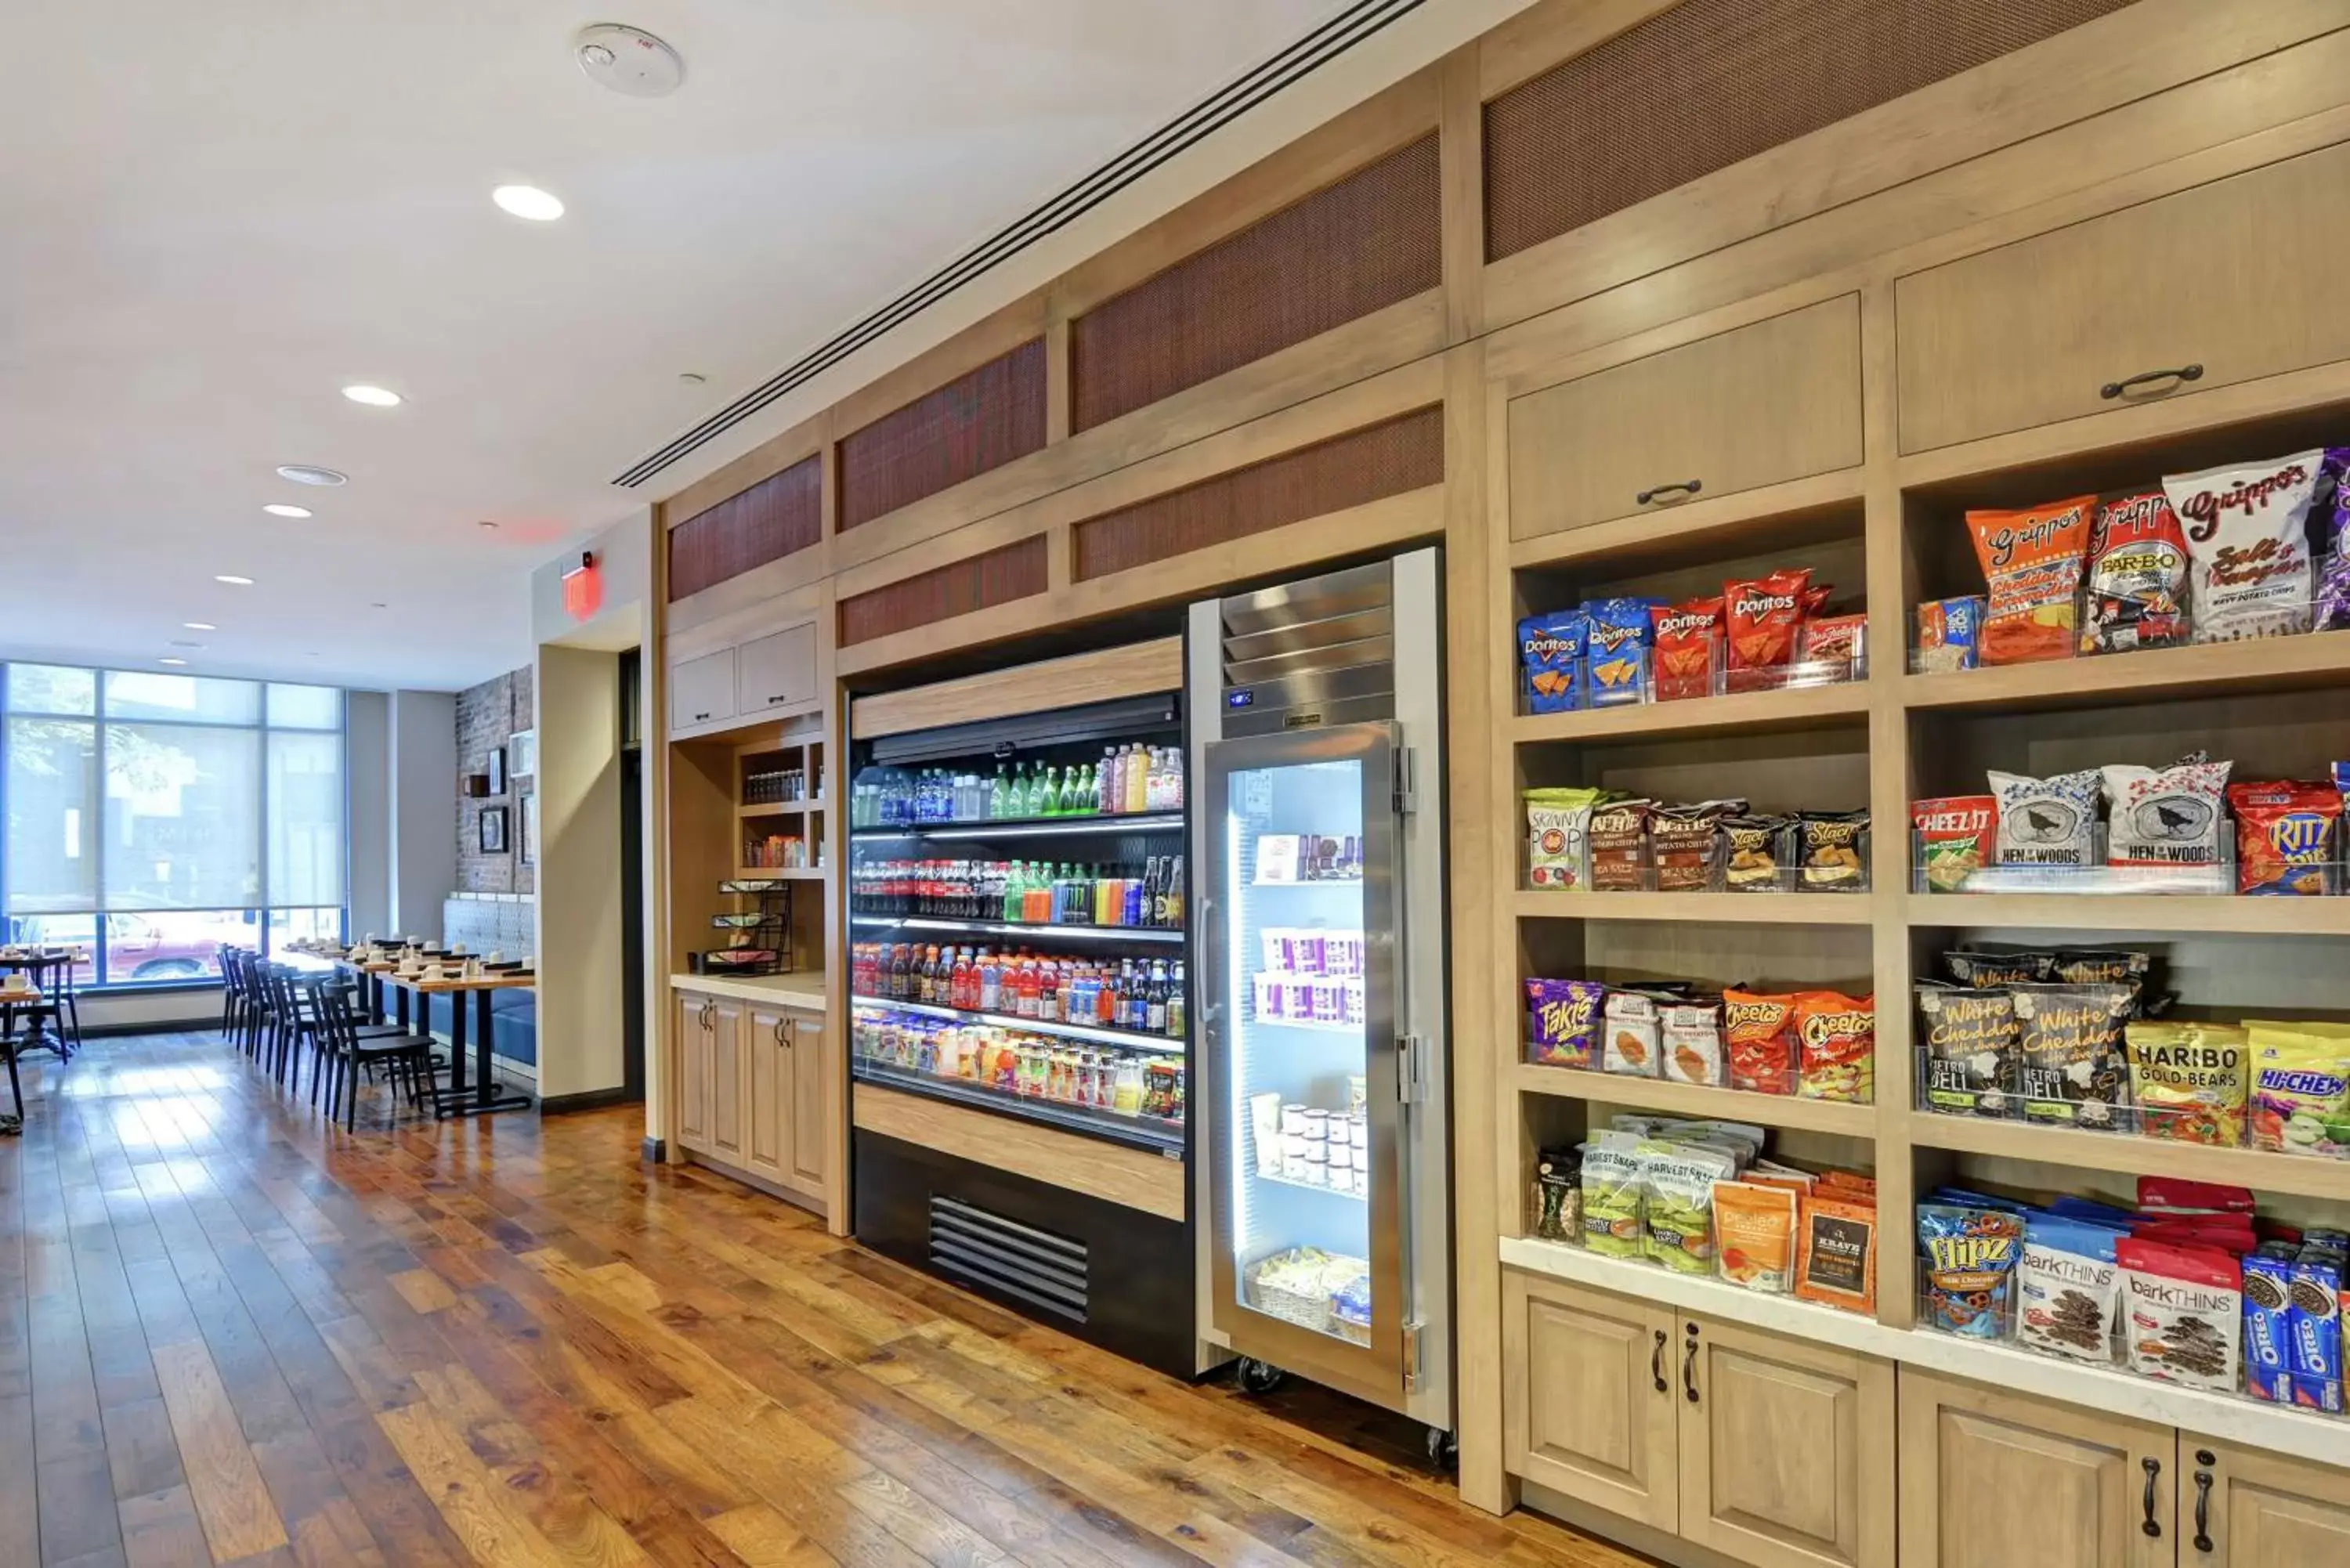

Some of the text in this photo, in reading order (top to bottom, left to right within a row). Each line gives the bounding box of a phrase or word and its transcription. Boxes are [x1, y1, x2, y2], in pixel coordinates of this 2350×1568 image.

[2181, 464, 2308, 542] Grippo's
[1987, 508, 2081, 566] Grippo's
[1735, 594, 1795, 617] Doritos
[1658, 614, 1716, 631] Doritos
[1525, 639, 1577, 653] Doritos
[1589, 627, 1643, 645] Doritos
[1532, 809, 1583, 827] SKINNY
[2272, 818, 2333, 852] RITZ
[2003, 848, 2026, 862] HEN
[2036, 848, 2081, 864] WOODS
[2128, 845, 2155, 861] HEN
[2167, 845, 2214, 862] WOODS
[1538, 999, 1593, 1040] Takis
[1726, 1003, 1785, 1028] Cheetos
[1946, 1000, 2011, 1024] White
[2040, 1005, 2106, 1031] White
[1930, 1020, 2023, 1044] Cheddar
[2023, 1027, 2121, 1052] Cheddar
[1929, 1058, 1966, 1074] METRO
[2136, 1045, 2238, 1069] HARIBO
[1930, 1071, 1967, 1091] DELI
[2023, 1067, 2060, 1084] METRO
[2139, 1067, 2237, 1087] GOLD-BEARS
[2024, 1080, 2063, 1100] DELI
[1647, 1163, 1689, 1176] HARVEST
[1817, 1237, 1860, 1253] KRAVE
[1929, 1235, 2011, 1274] flipz
[2023, 1252, 2112, 1286] barkTHINS
[2129, 1275, 2229, 1312] barkTHINS
[2254, 1311, 2279, 1365] OREO
[2301, 1318, 2326, 1374] OREO
